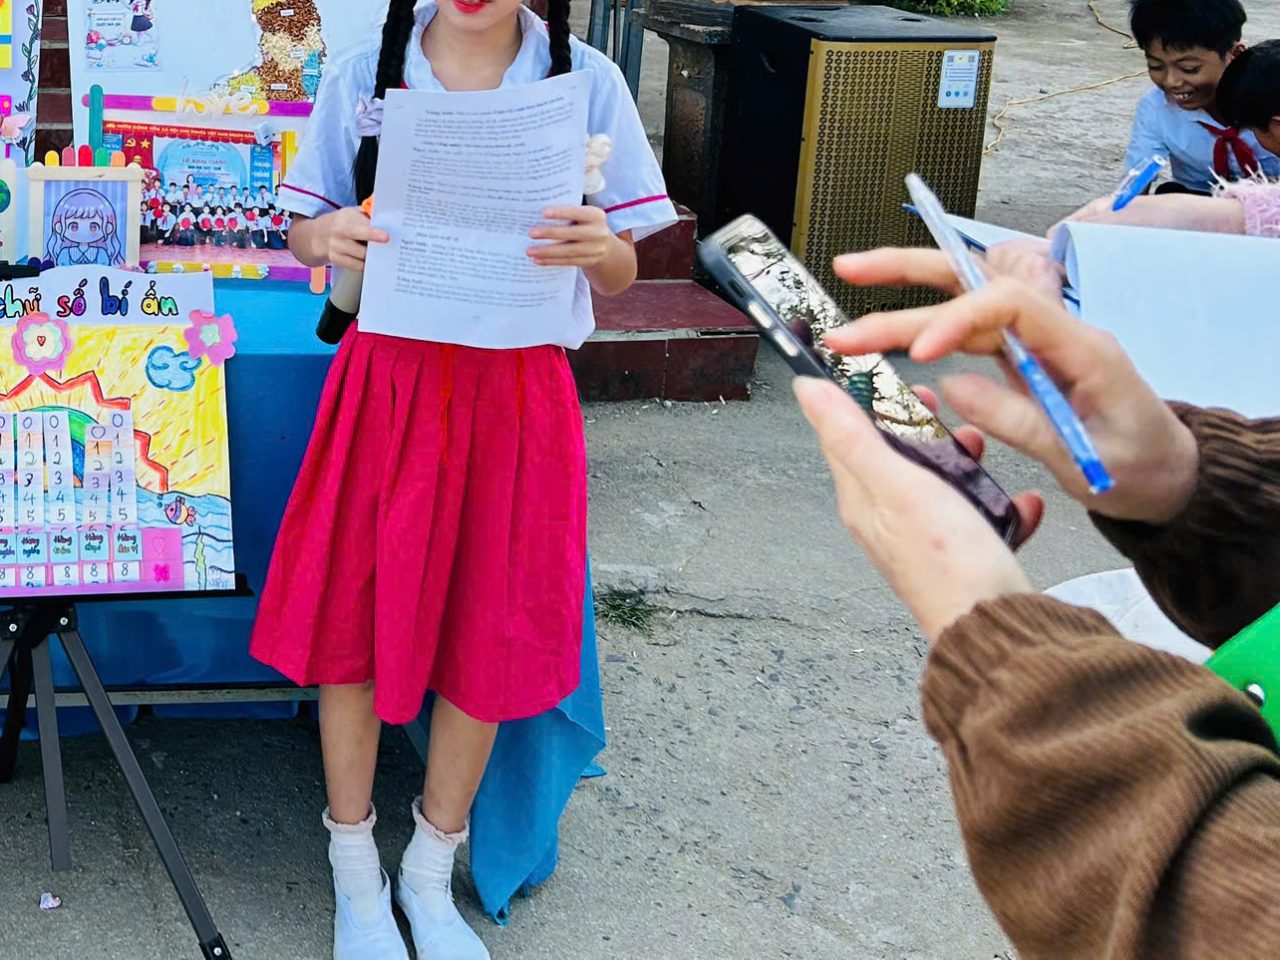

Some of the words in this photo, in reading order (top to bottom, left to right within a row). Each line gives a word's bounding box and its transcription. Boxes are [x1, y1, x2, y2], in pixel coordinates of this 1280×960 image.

[57, 279, 88, 317] số
[99, 277, 133, 317] bí
[140, 280, 179, 317] ẩn
